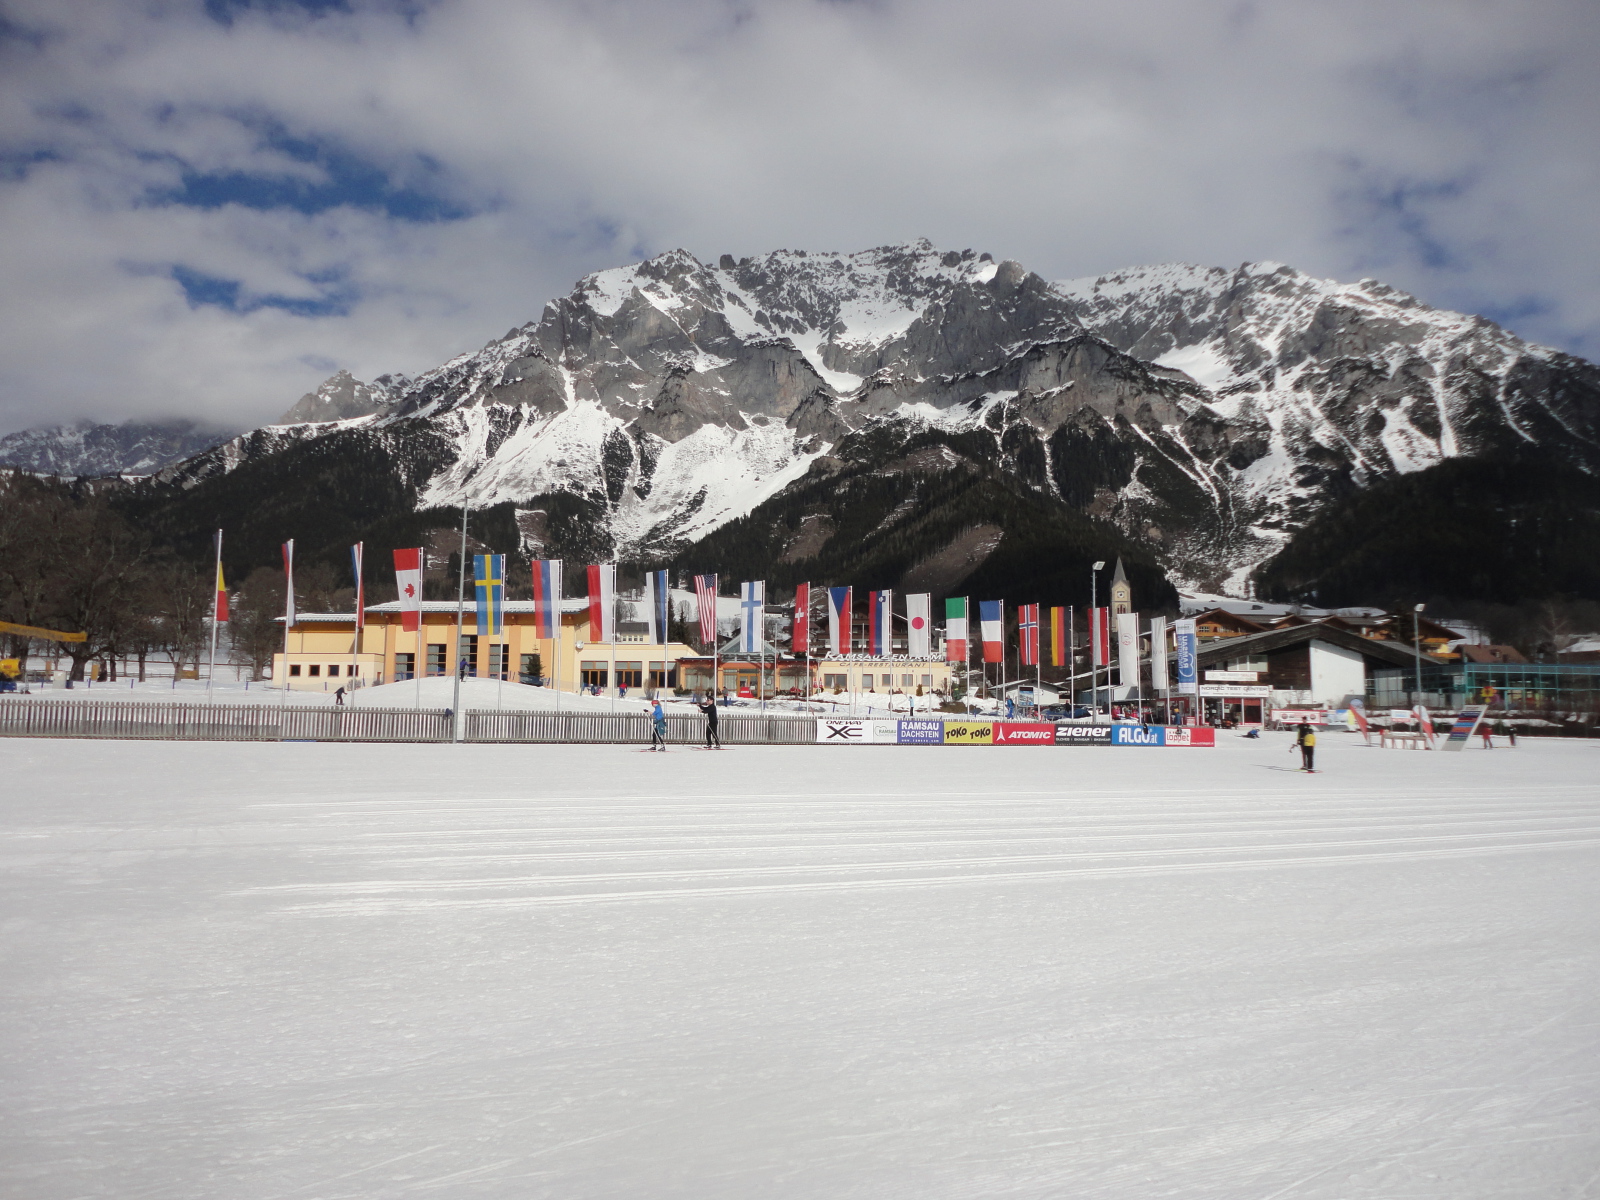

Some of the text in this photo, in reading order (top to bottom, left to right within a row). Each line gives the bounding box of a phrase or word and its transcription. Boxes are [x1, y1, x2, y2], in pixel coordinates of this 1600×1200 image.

[901, 721, 940, 731] RAMSAU
[901, 730, 940, 738] DACHSTEIN
[946, 726, 968, 739] TOKO
[970, 726, 991, 740] TOKO
[1008, 730, 1052, 739] ATOMIC
